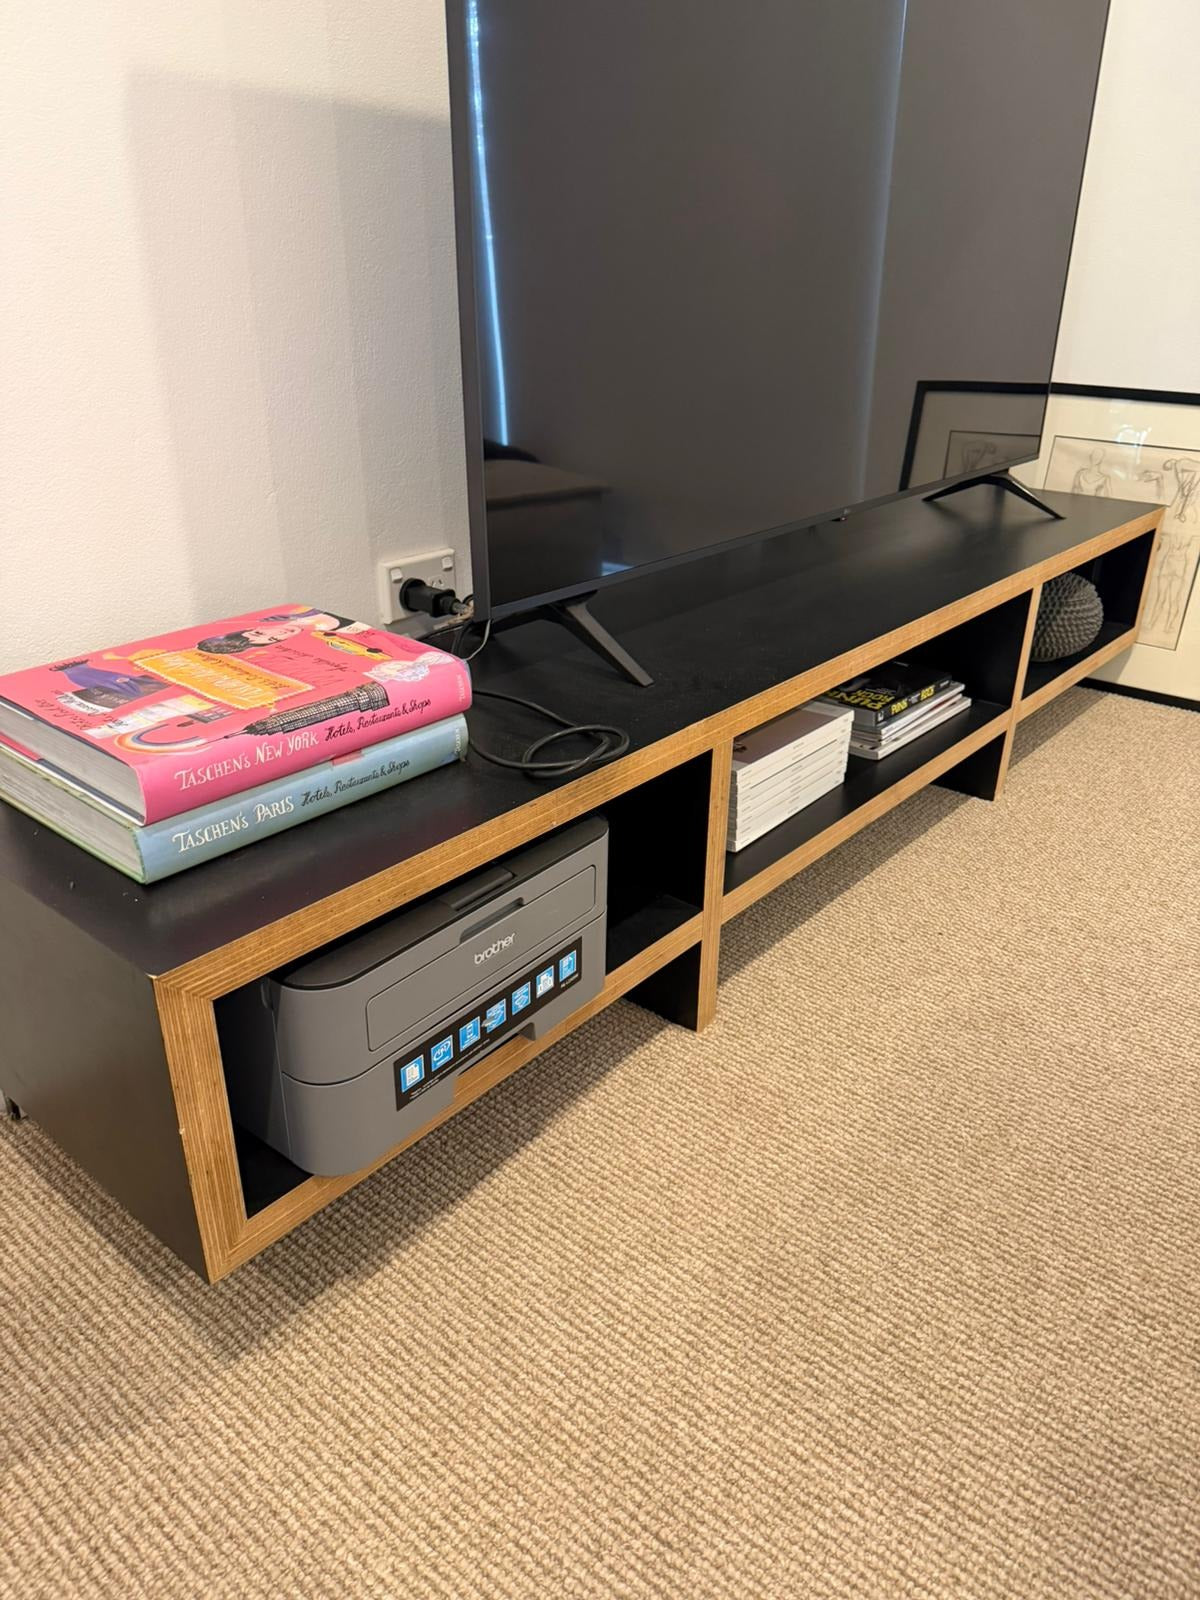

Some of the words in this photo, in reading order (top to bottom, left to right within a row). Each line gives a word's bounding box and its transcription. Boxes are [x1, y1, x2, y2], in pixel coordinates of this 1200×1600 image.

[254, 741, 284, 765] NEW
[286, 731, 319, 755] YORK
[324, 721, 356, 742] Hotels,
[356, 709, 402, 731] Restaurants
[401, 703, 409, 716] &
[408, 698, 432, 716] Shops
[253, 796, 295, 824] PARIS
[301, 786, 333, 807] Hotels,
[334, 772, 380, 794] Restaurants
[379, 764, 388, 777] &
[387, 759, 410, 776] Shops
[473, 932, 517, 965] brother
